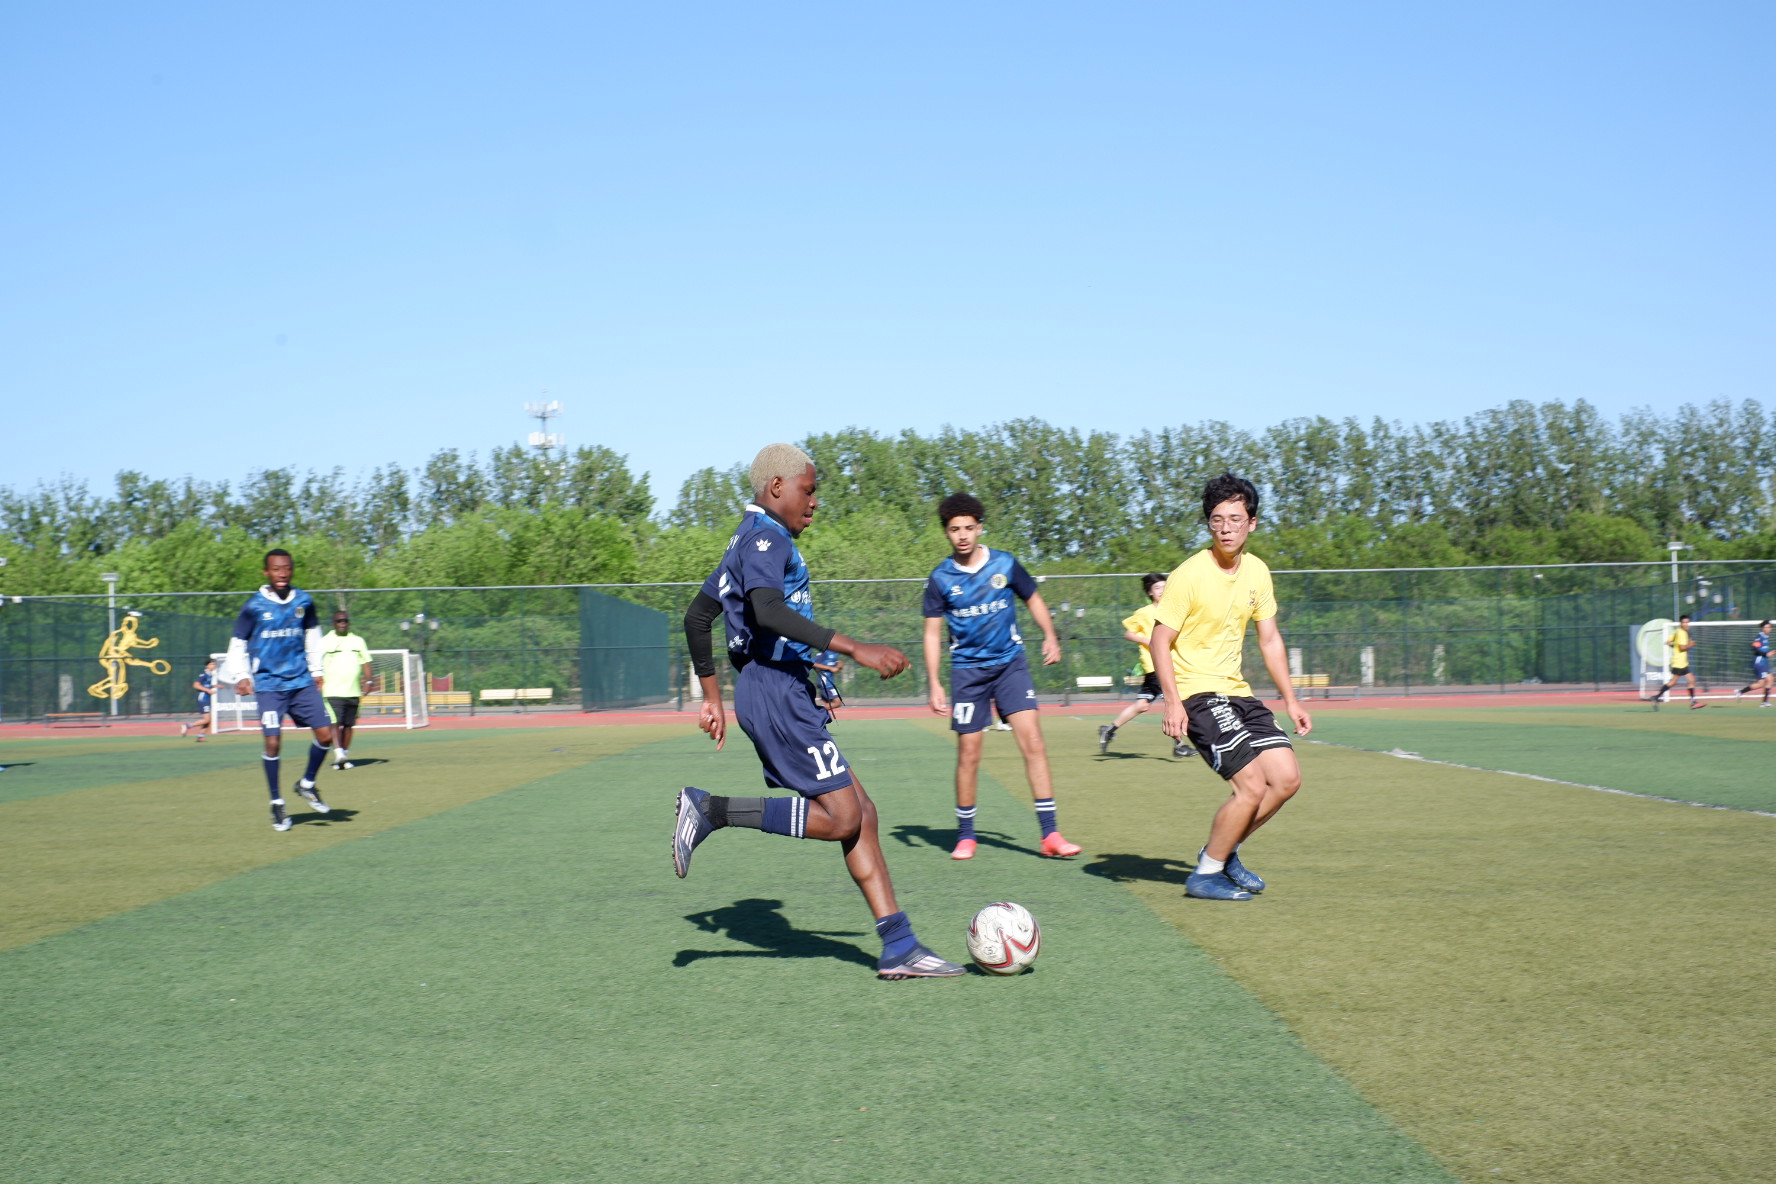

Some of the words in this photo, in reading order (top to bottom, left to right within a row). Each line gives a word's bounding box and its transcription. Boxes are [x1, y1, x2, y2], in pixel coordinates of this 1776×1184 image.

[953, 702, 975, 724] 47
[1210, 705, 1233, 733] BETTER
[807, 740, 846, 780] 12
